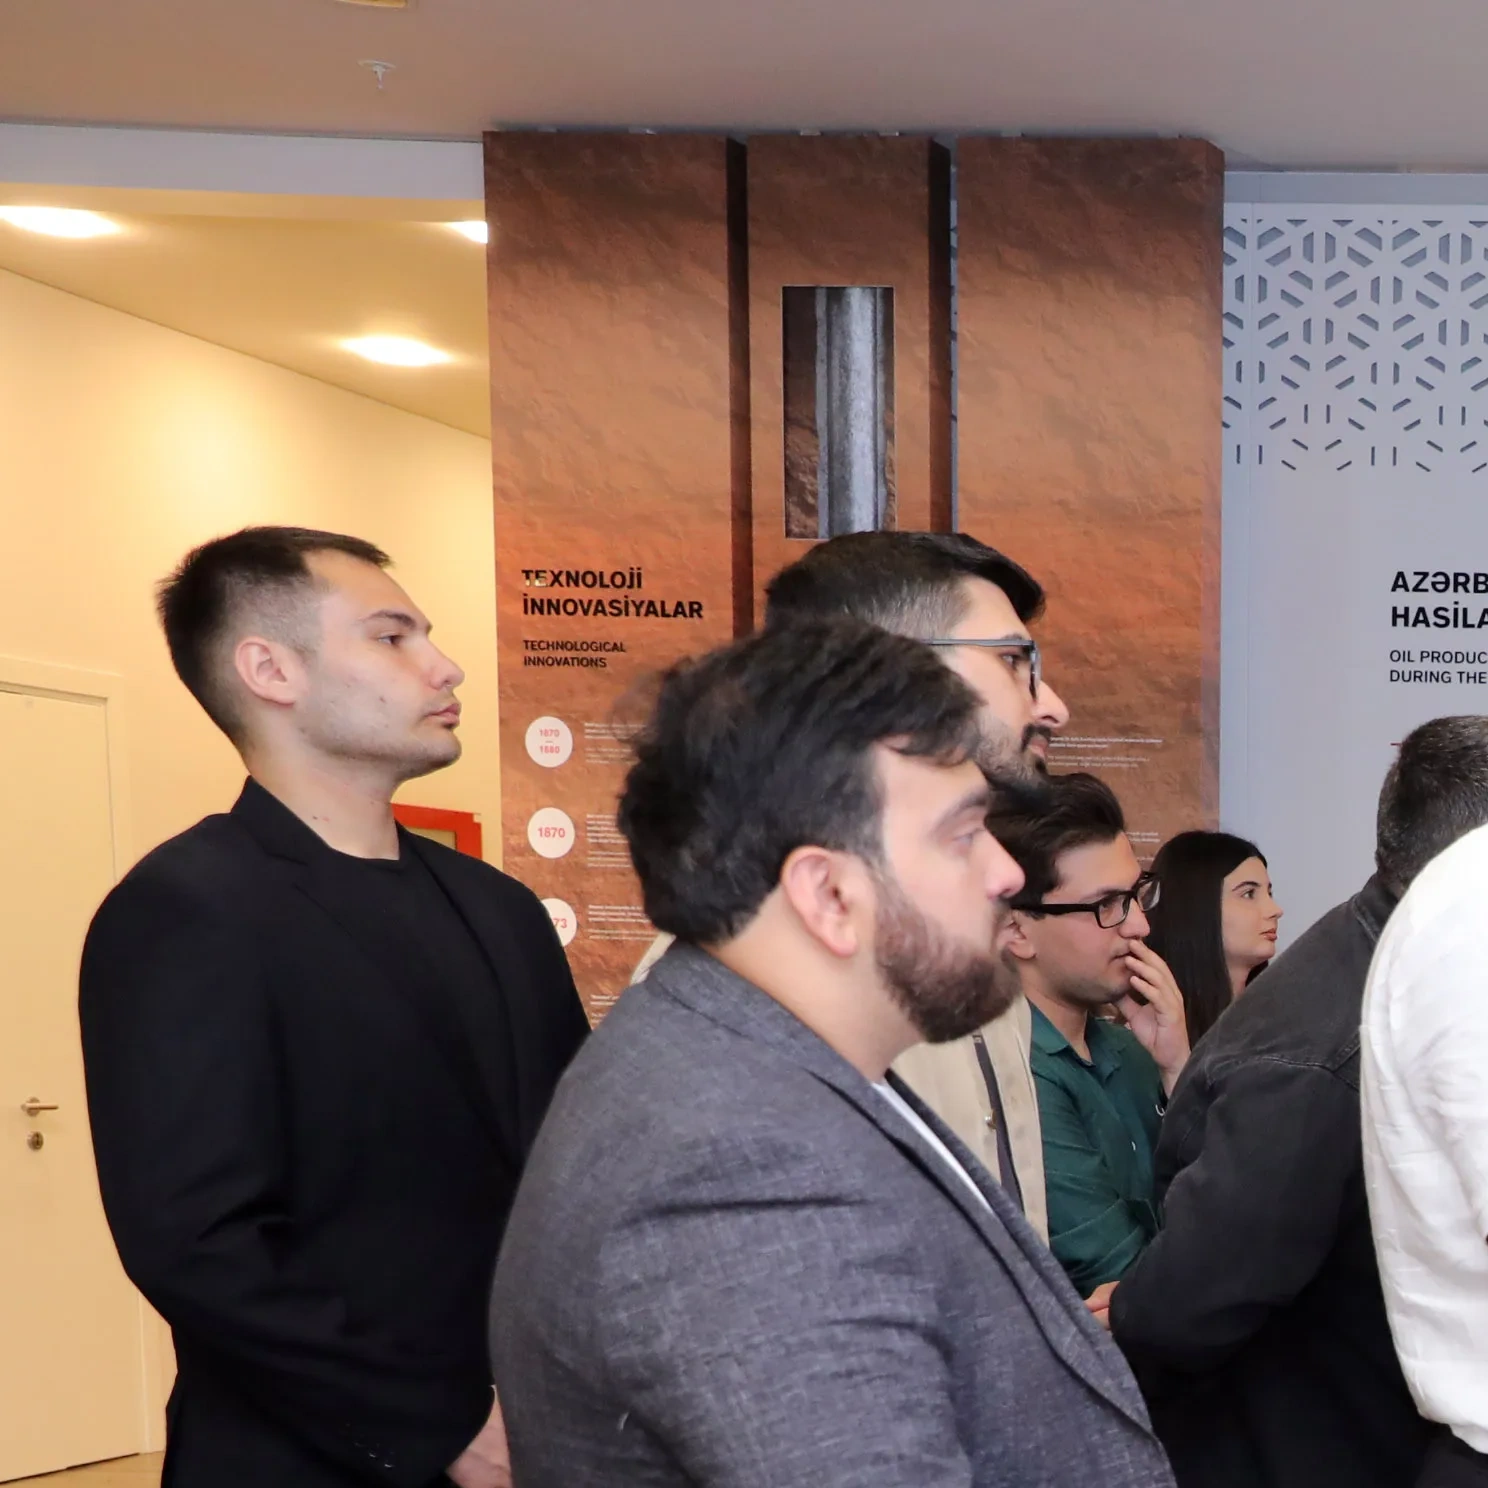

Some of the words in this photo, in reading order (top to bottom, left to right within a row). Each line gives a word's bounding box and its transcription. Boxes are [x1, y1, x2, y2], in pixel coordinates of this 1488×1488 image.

[521, 567, 642, 589] TEXNOLOJİ
[523, 593, 703, 618] İNNOVASİYALAR
[523, 639, 626, 653] TECHNOLOGICAL
[524, 656, 607, 668] INNOVATIONS
[1390, 650, 1415, 663] OIL
[1390, 670, 1452, 683] DURING
[1457, 671, 1487, 684] THE
[537, 827, 566, 839] 1870
[553, 918, 567, 929] 73
